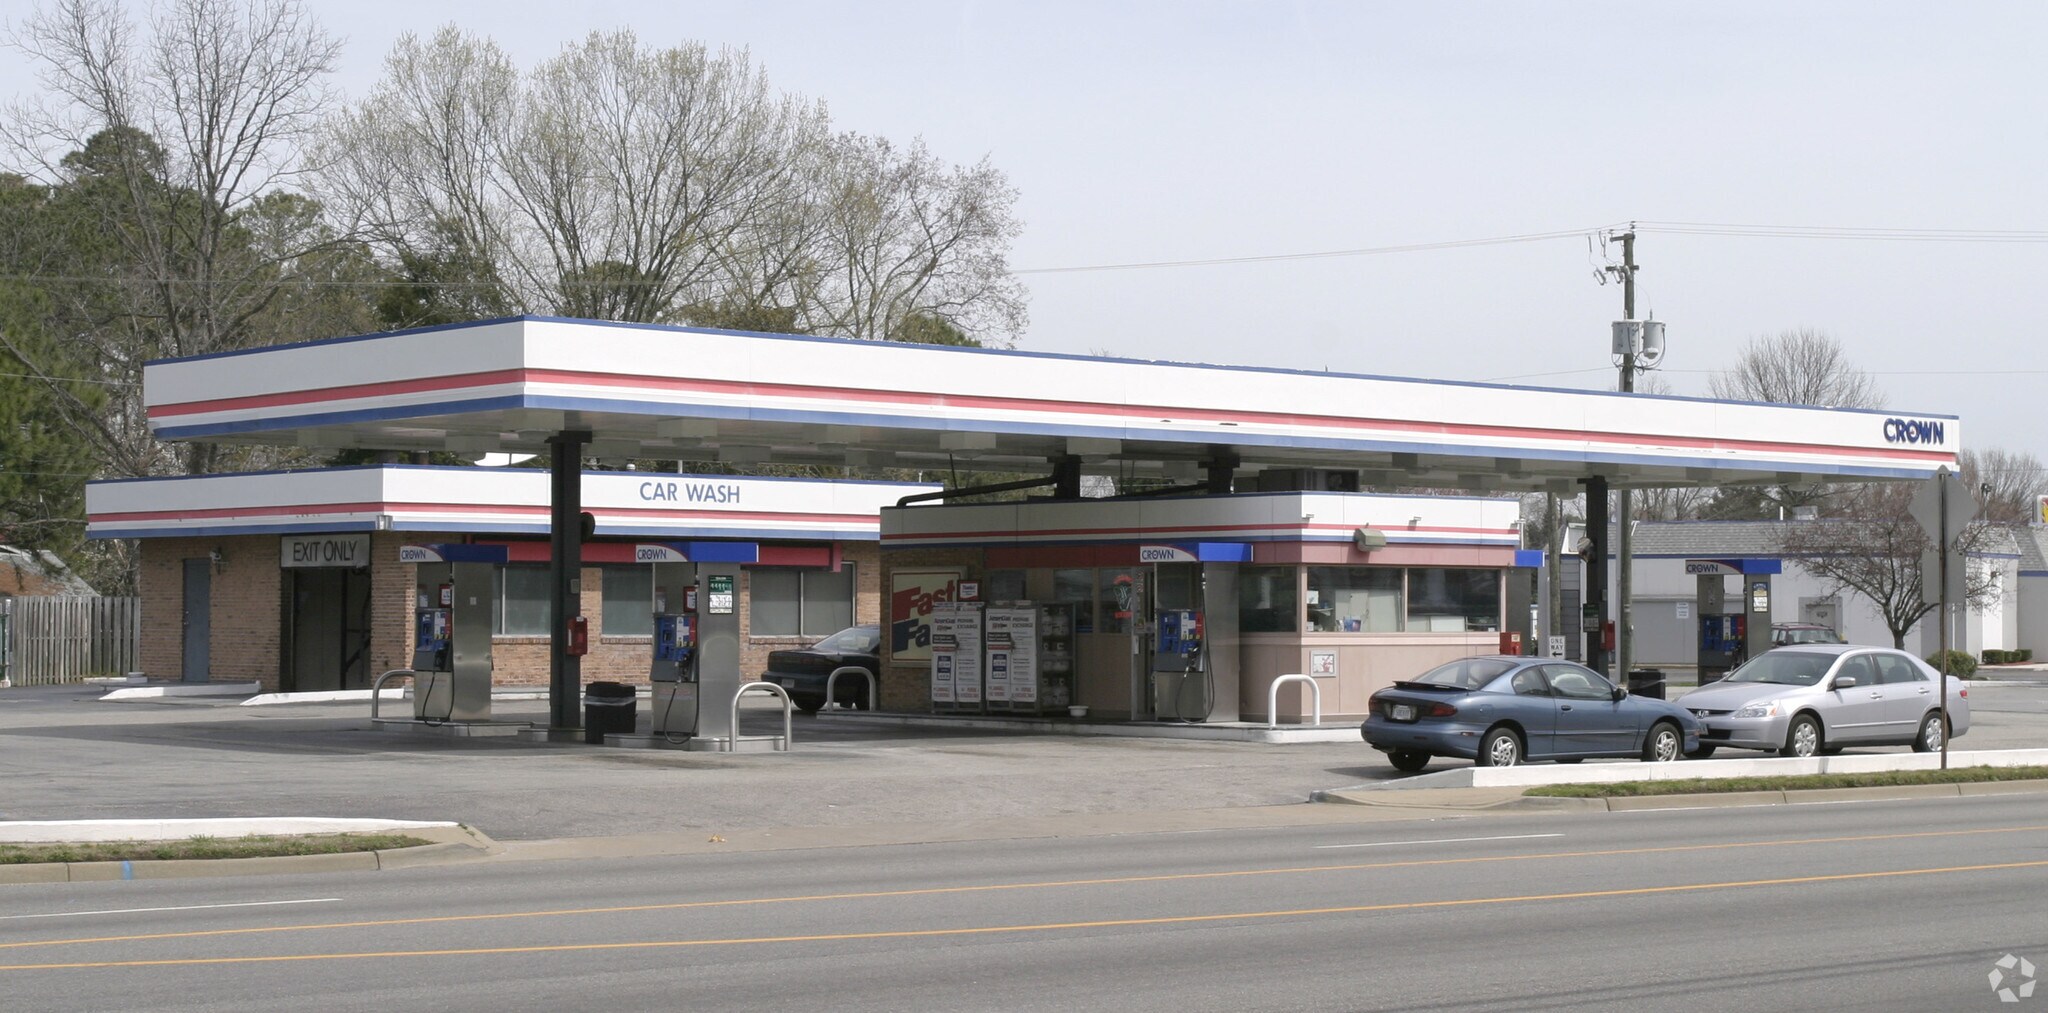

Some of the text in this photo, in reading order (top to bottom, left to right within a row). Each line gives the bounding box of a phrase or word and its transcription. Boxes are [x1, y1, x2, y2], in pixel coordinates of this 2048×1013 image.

[1883, 418, 1944, 445] CROWN
[640, 482, 740, 503] CAR WASH
[293, 540, 357, 562] EXIT ONLY
[401, 549, 426, 560] CROWN
[637, 548, 667, 560] CROWN
[1141, 549, 1174, 560] CROWN
[1686, 563, 1718, 573] CROWN
[892, 580, 955, 621] Fast
